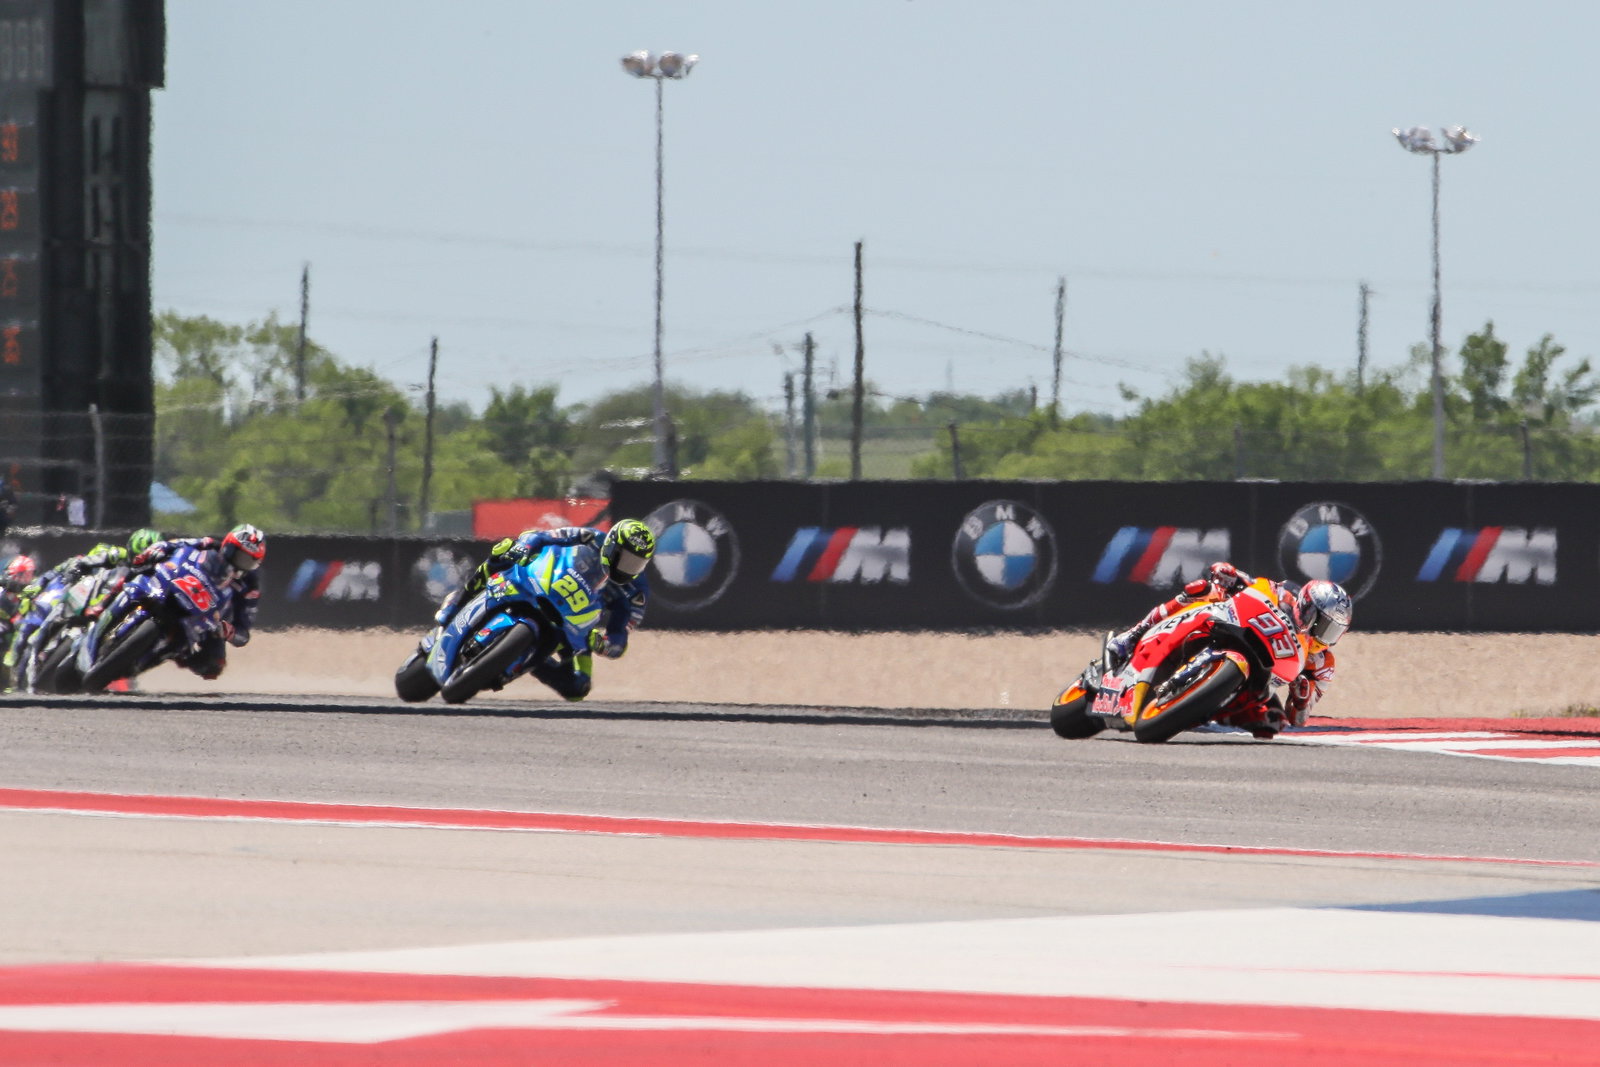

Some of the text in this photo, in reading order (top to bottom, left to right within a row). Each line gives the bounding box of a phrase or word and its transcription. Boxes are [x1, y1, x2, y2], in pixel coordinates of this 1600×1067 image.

[963, 504, 1045, 540] BMW
[1286, 505, 1370, 537] BMW
[551, 575, 590, 613] 29
[1248, 612, 1295, 659] 93
